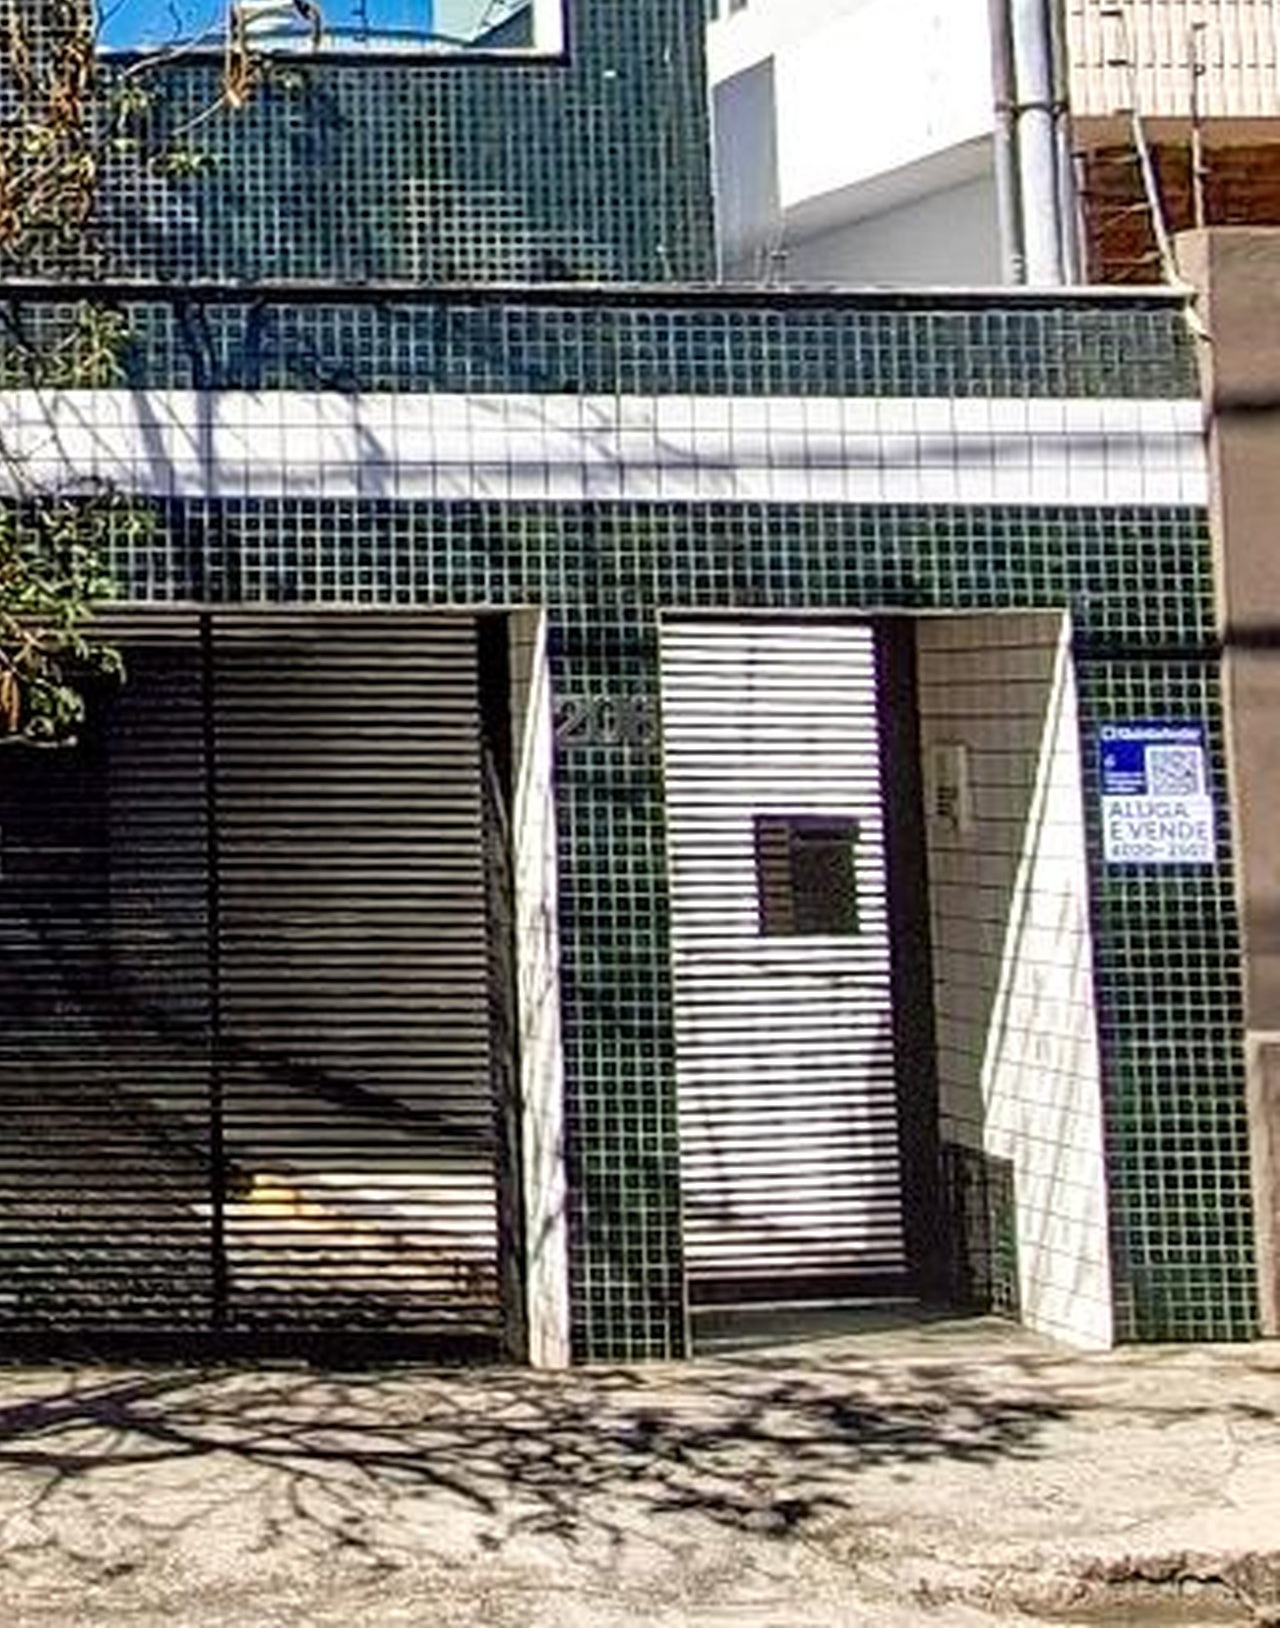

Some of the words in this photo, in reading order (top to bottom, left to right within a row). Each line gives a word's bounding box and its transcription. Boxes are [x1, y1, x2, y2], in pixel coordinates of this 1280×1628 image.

[1109, 800, 1190, 819] ALUGA
[1110, 821, 1123, 841] E
[1127, 821, 1209, 841] VENDE
